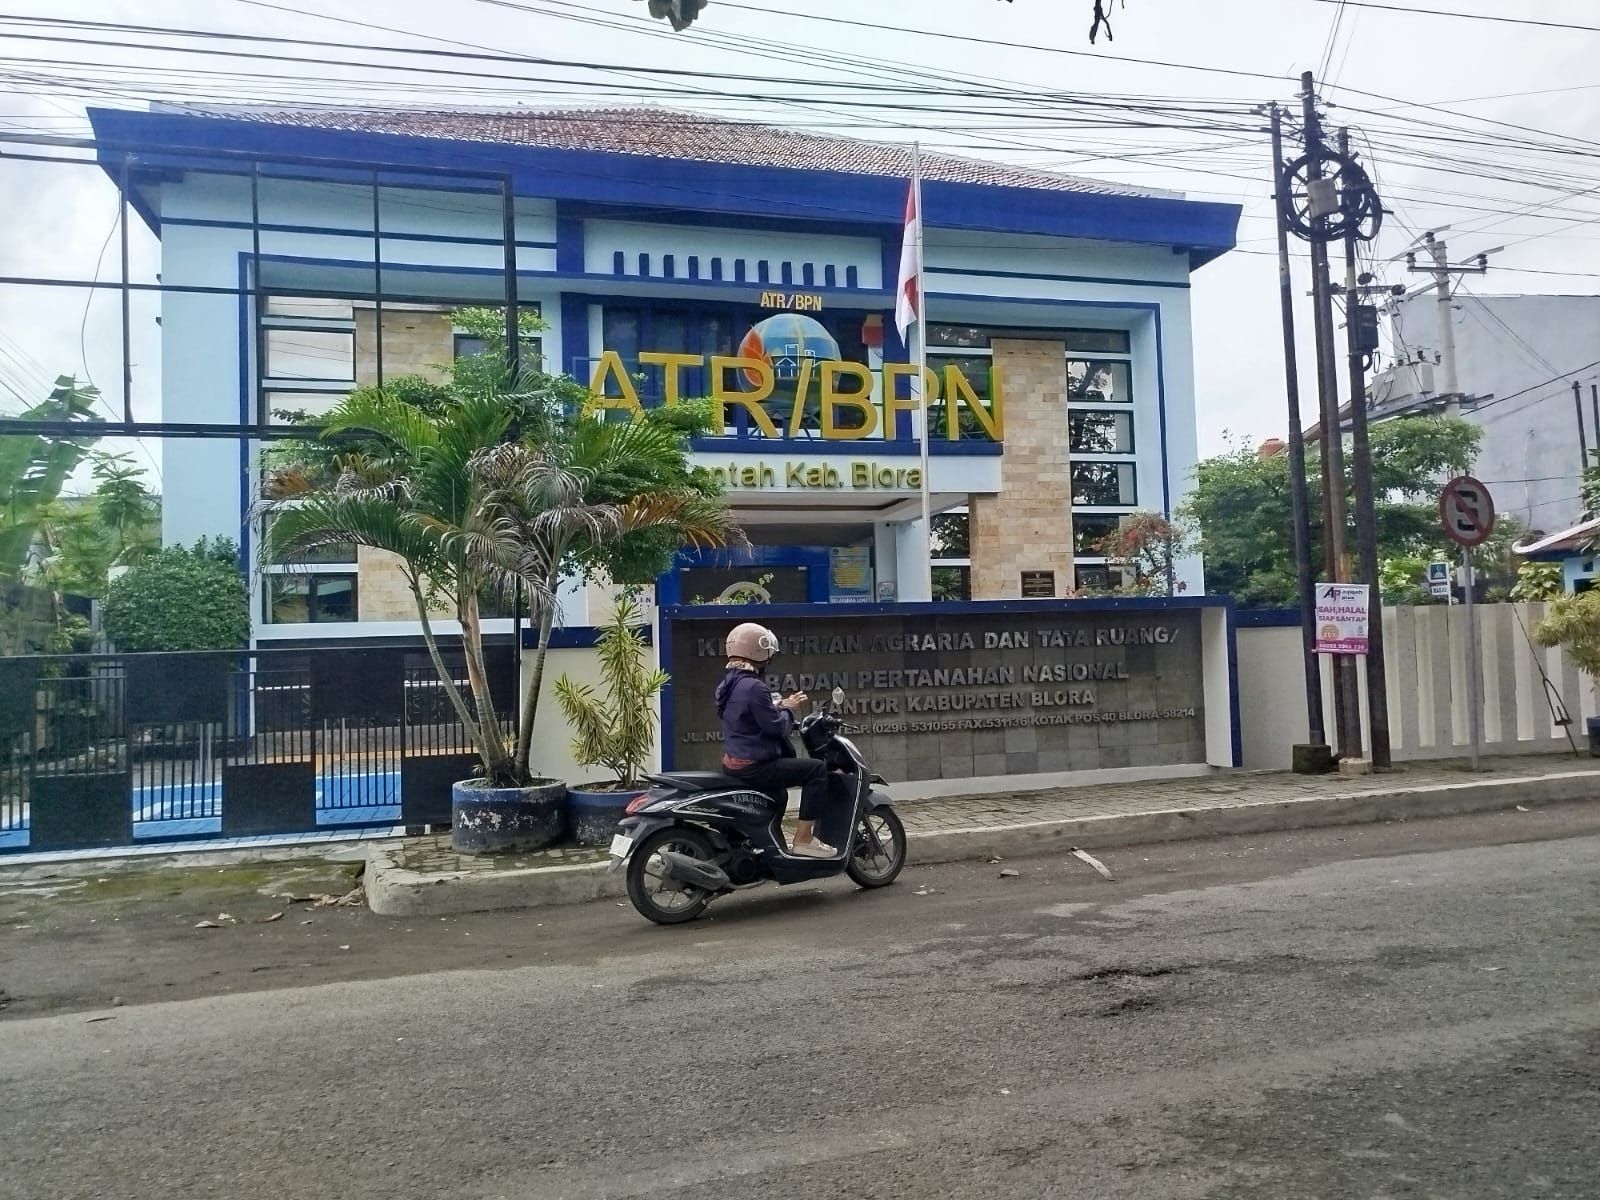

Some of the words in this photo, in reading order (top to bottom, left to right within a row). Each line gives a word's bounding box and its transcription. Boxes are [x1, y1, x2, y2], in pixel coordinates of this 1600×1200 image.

[760, 292, 822, 311] ATR/BPN
[581, 350, 1003, 440] ATR/BPN
[786, 461, 844, 489] Kab.
[852, 462, 922, 489] Blora
[871, 630, 975, 653] AGRARIA
[984, 630, 1029, 649] DAN
[1037, 629, 1089, 648] TATA
[1096, 626, 1181, 647] RUANG/
[765, 672, 848, 692] BADAN
[858, 665, 1014, 689] PERTANAHAN
[1023, 661, 1129, 682] NASIONAL
[812, 696, 899, 715] KANTOR
[907, 692, 1025, 712] KABUPATEN
[1031, 688, 1097, 707] BLORA
[911, 719, 955, 731] 531055
[1031, 714, 1071, 726] KOTAK
[1076, 712, 1100, 723] POS
[1102, 711, 1116, 721] 40
